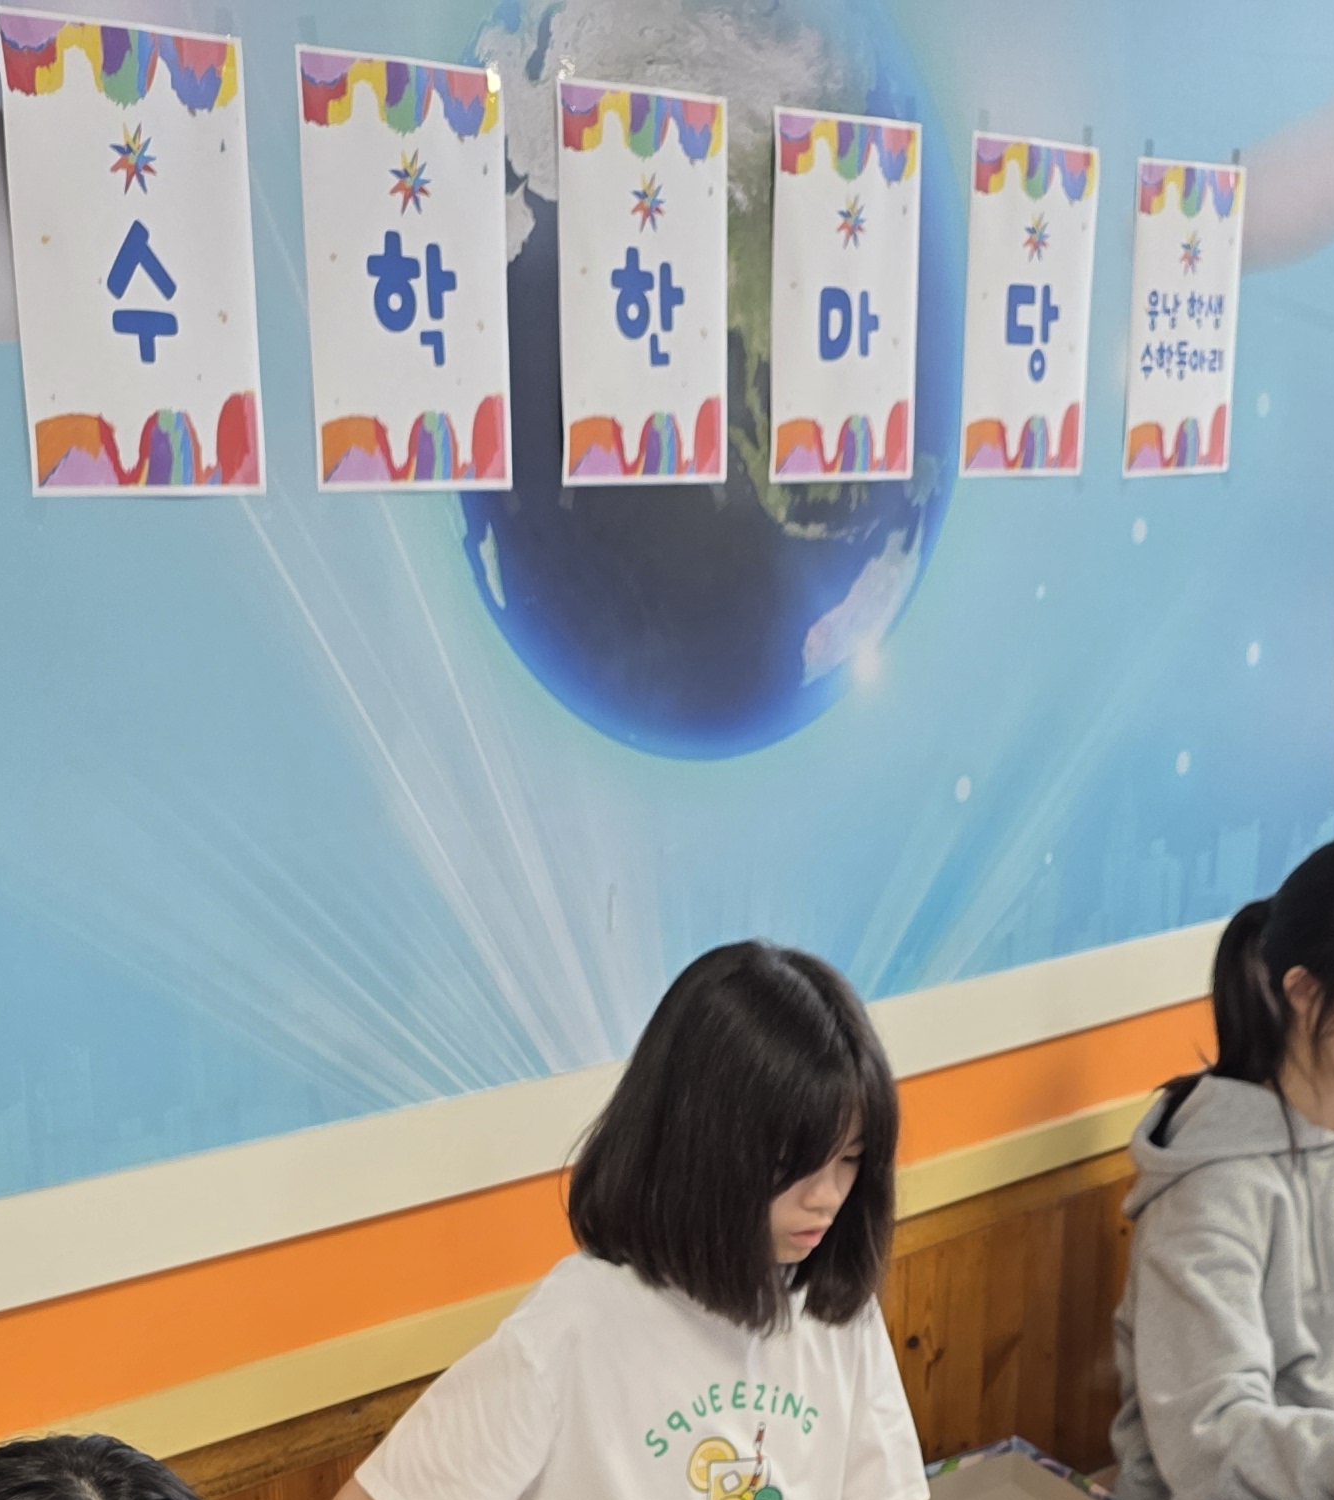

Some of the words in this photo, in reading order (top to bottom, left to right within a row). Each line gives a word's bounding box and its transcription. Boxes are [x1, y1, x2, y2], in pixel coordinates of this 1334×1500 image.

[106, 219, 177, 362] 수
[366, 231, 457, 366] 학
[610, 247, 685, 366] 한
[818, 286, 880, 361] 마
[1005, 283, 1060, 382] 당
[1140, 340, 1224, 382] 수학동아리
